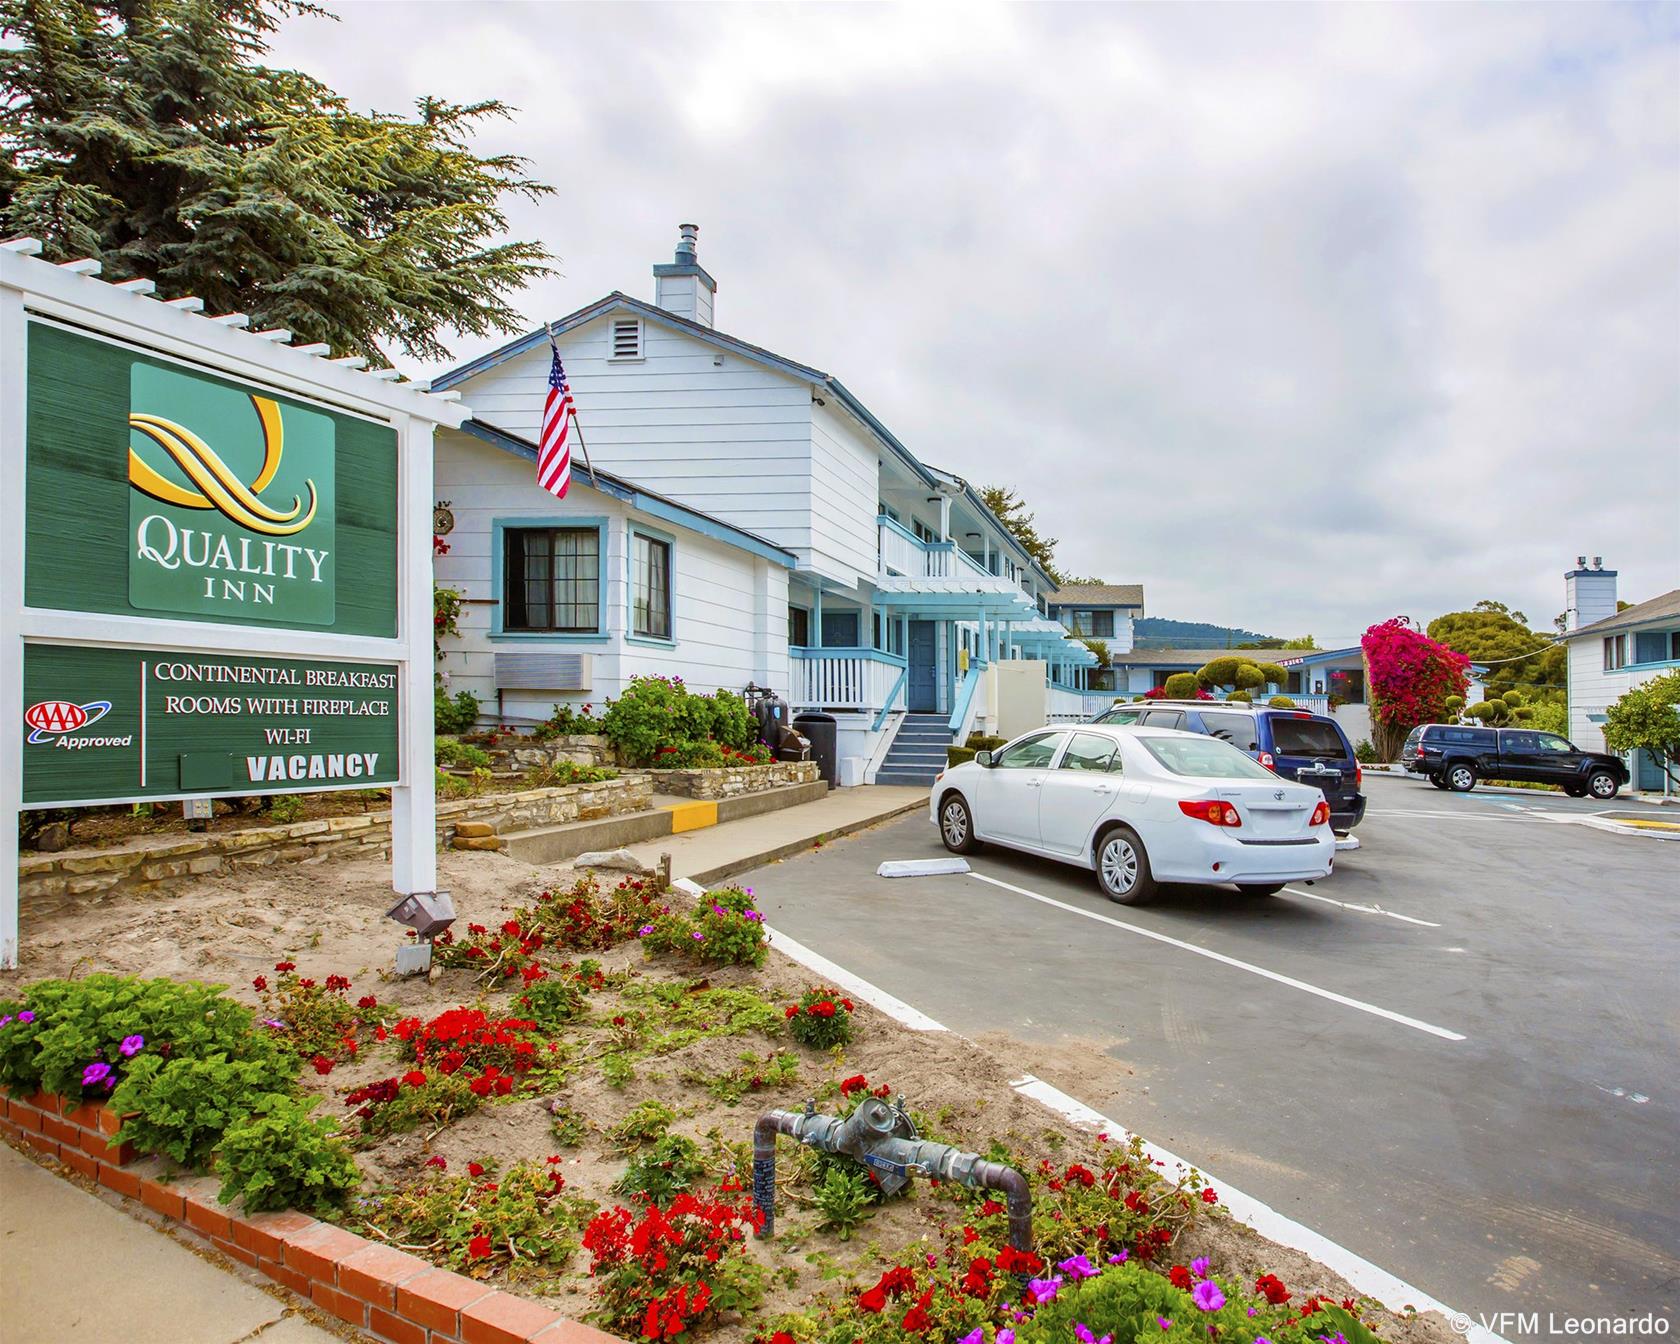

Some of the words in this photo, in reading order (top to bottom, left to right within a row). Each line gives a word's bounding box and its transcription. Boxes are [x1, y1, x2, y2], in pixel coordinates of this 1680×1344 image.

[137, 514, 329, 582] QUALITY
[203, 577, 275, 605] INN
[154, 662, 301, 686] CONTINENTAL
[305, 669, 397, 689] BREAKFAST
[33, 704, 79, 731] AAA
[165, 696, 241, 714] ROOMS
[246, 697, 298, 715] WITH
[302, 699, 389, 717] FIREPLACE
[55, 735, 132, 750] Approved
[264, 728, 311, 745] WI-FI
[246, 753, 379, 782] VACANCY
